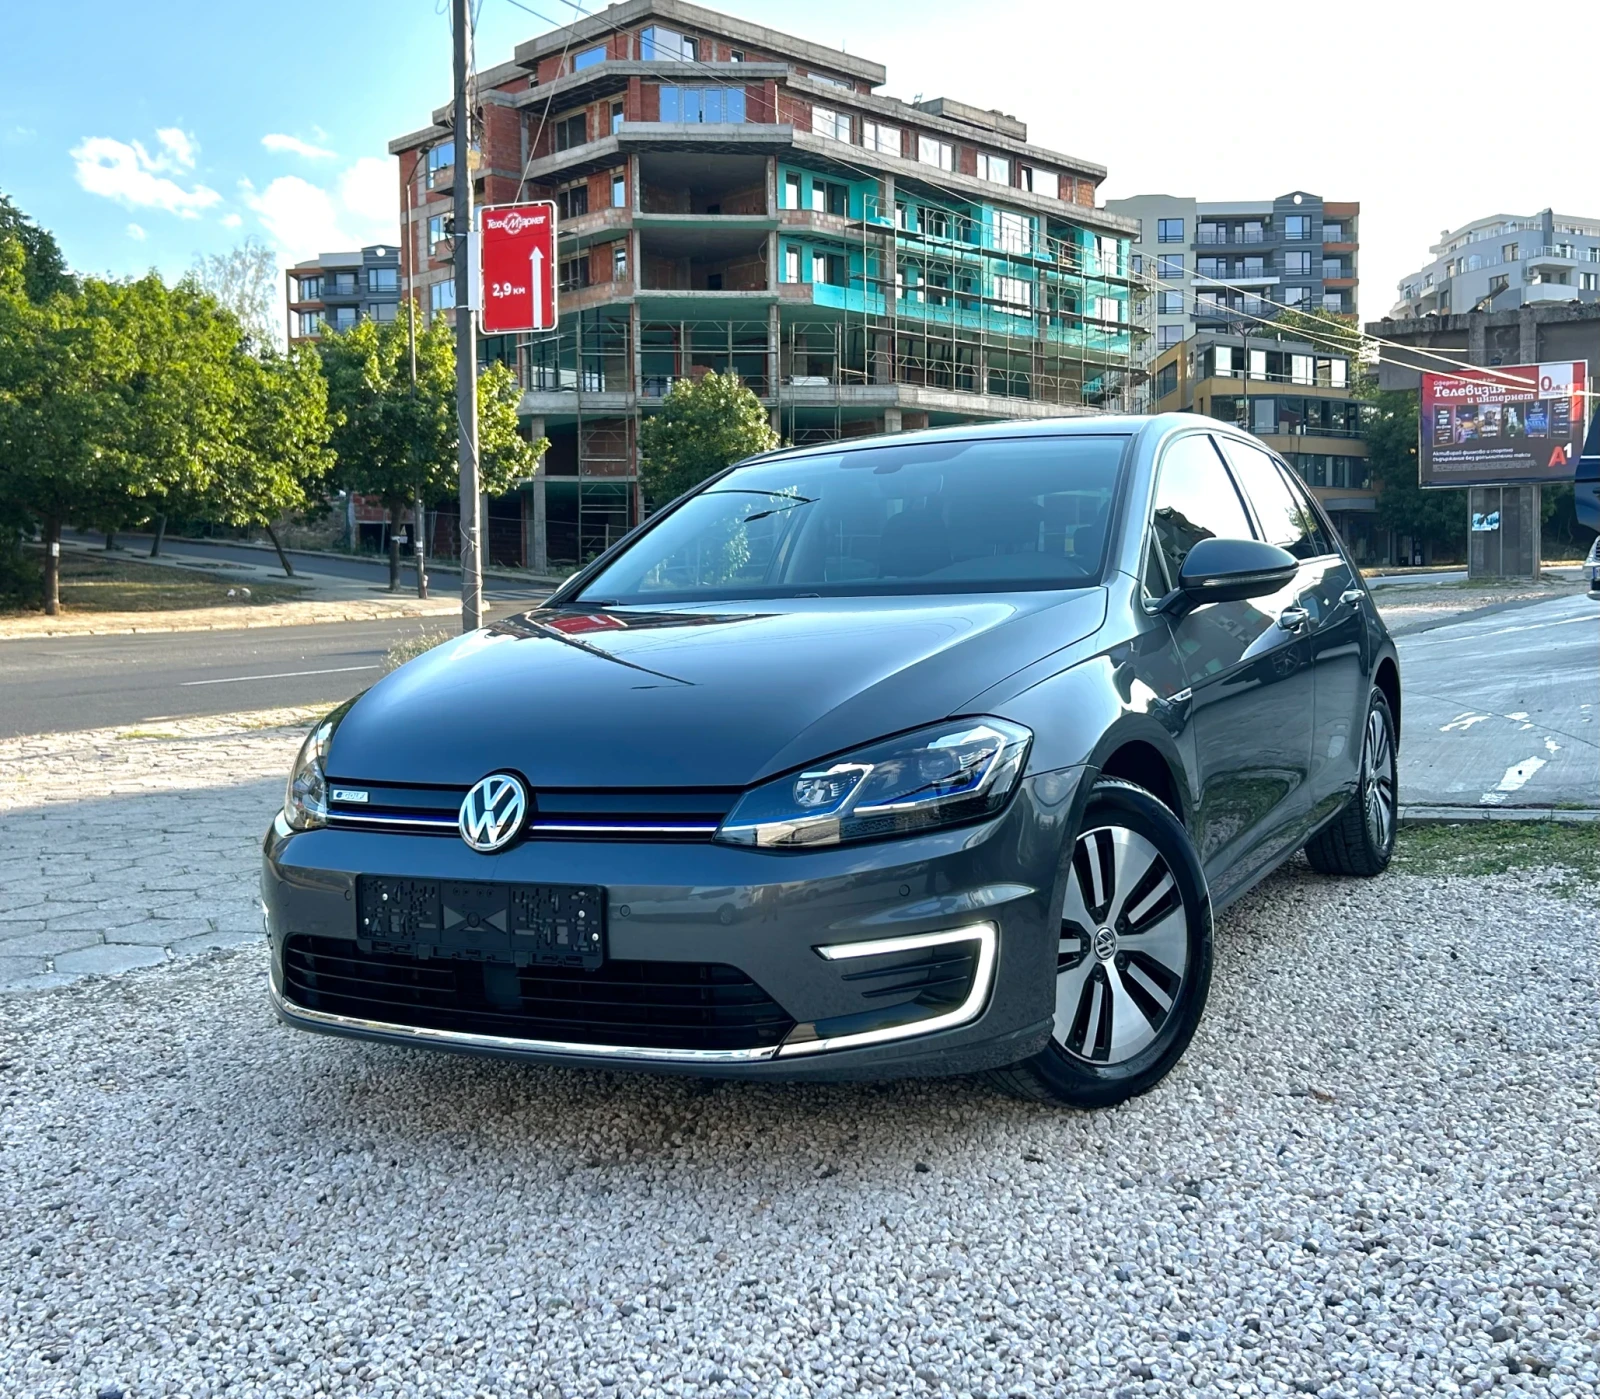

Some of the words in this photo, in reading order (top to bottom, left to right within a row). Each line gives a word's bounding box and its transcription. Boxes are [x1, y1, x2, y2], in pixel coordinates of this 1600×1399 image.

[492, 282, 512, 298] 2,9
[1433, 384, 1506, 398] Телевизия
[1476, 393, 1534, 403] интернет
[459, 774, 525, 851] VW
